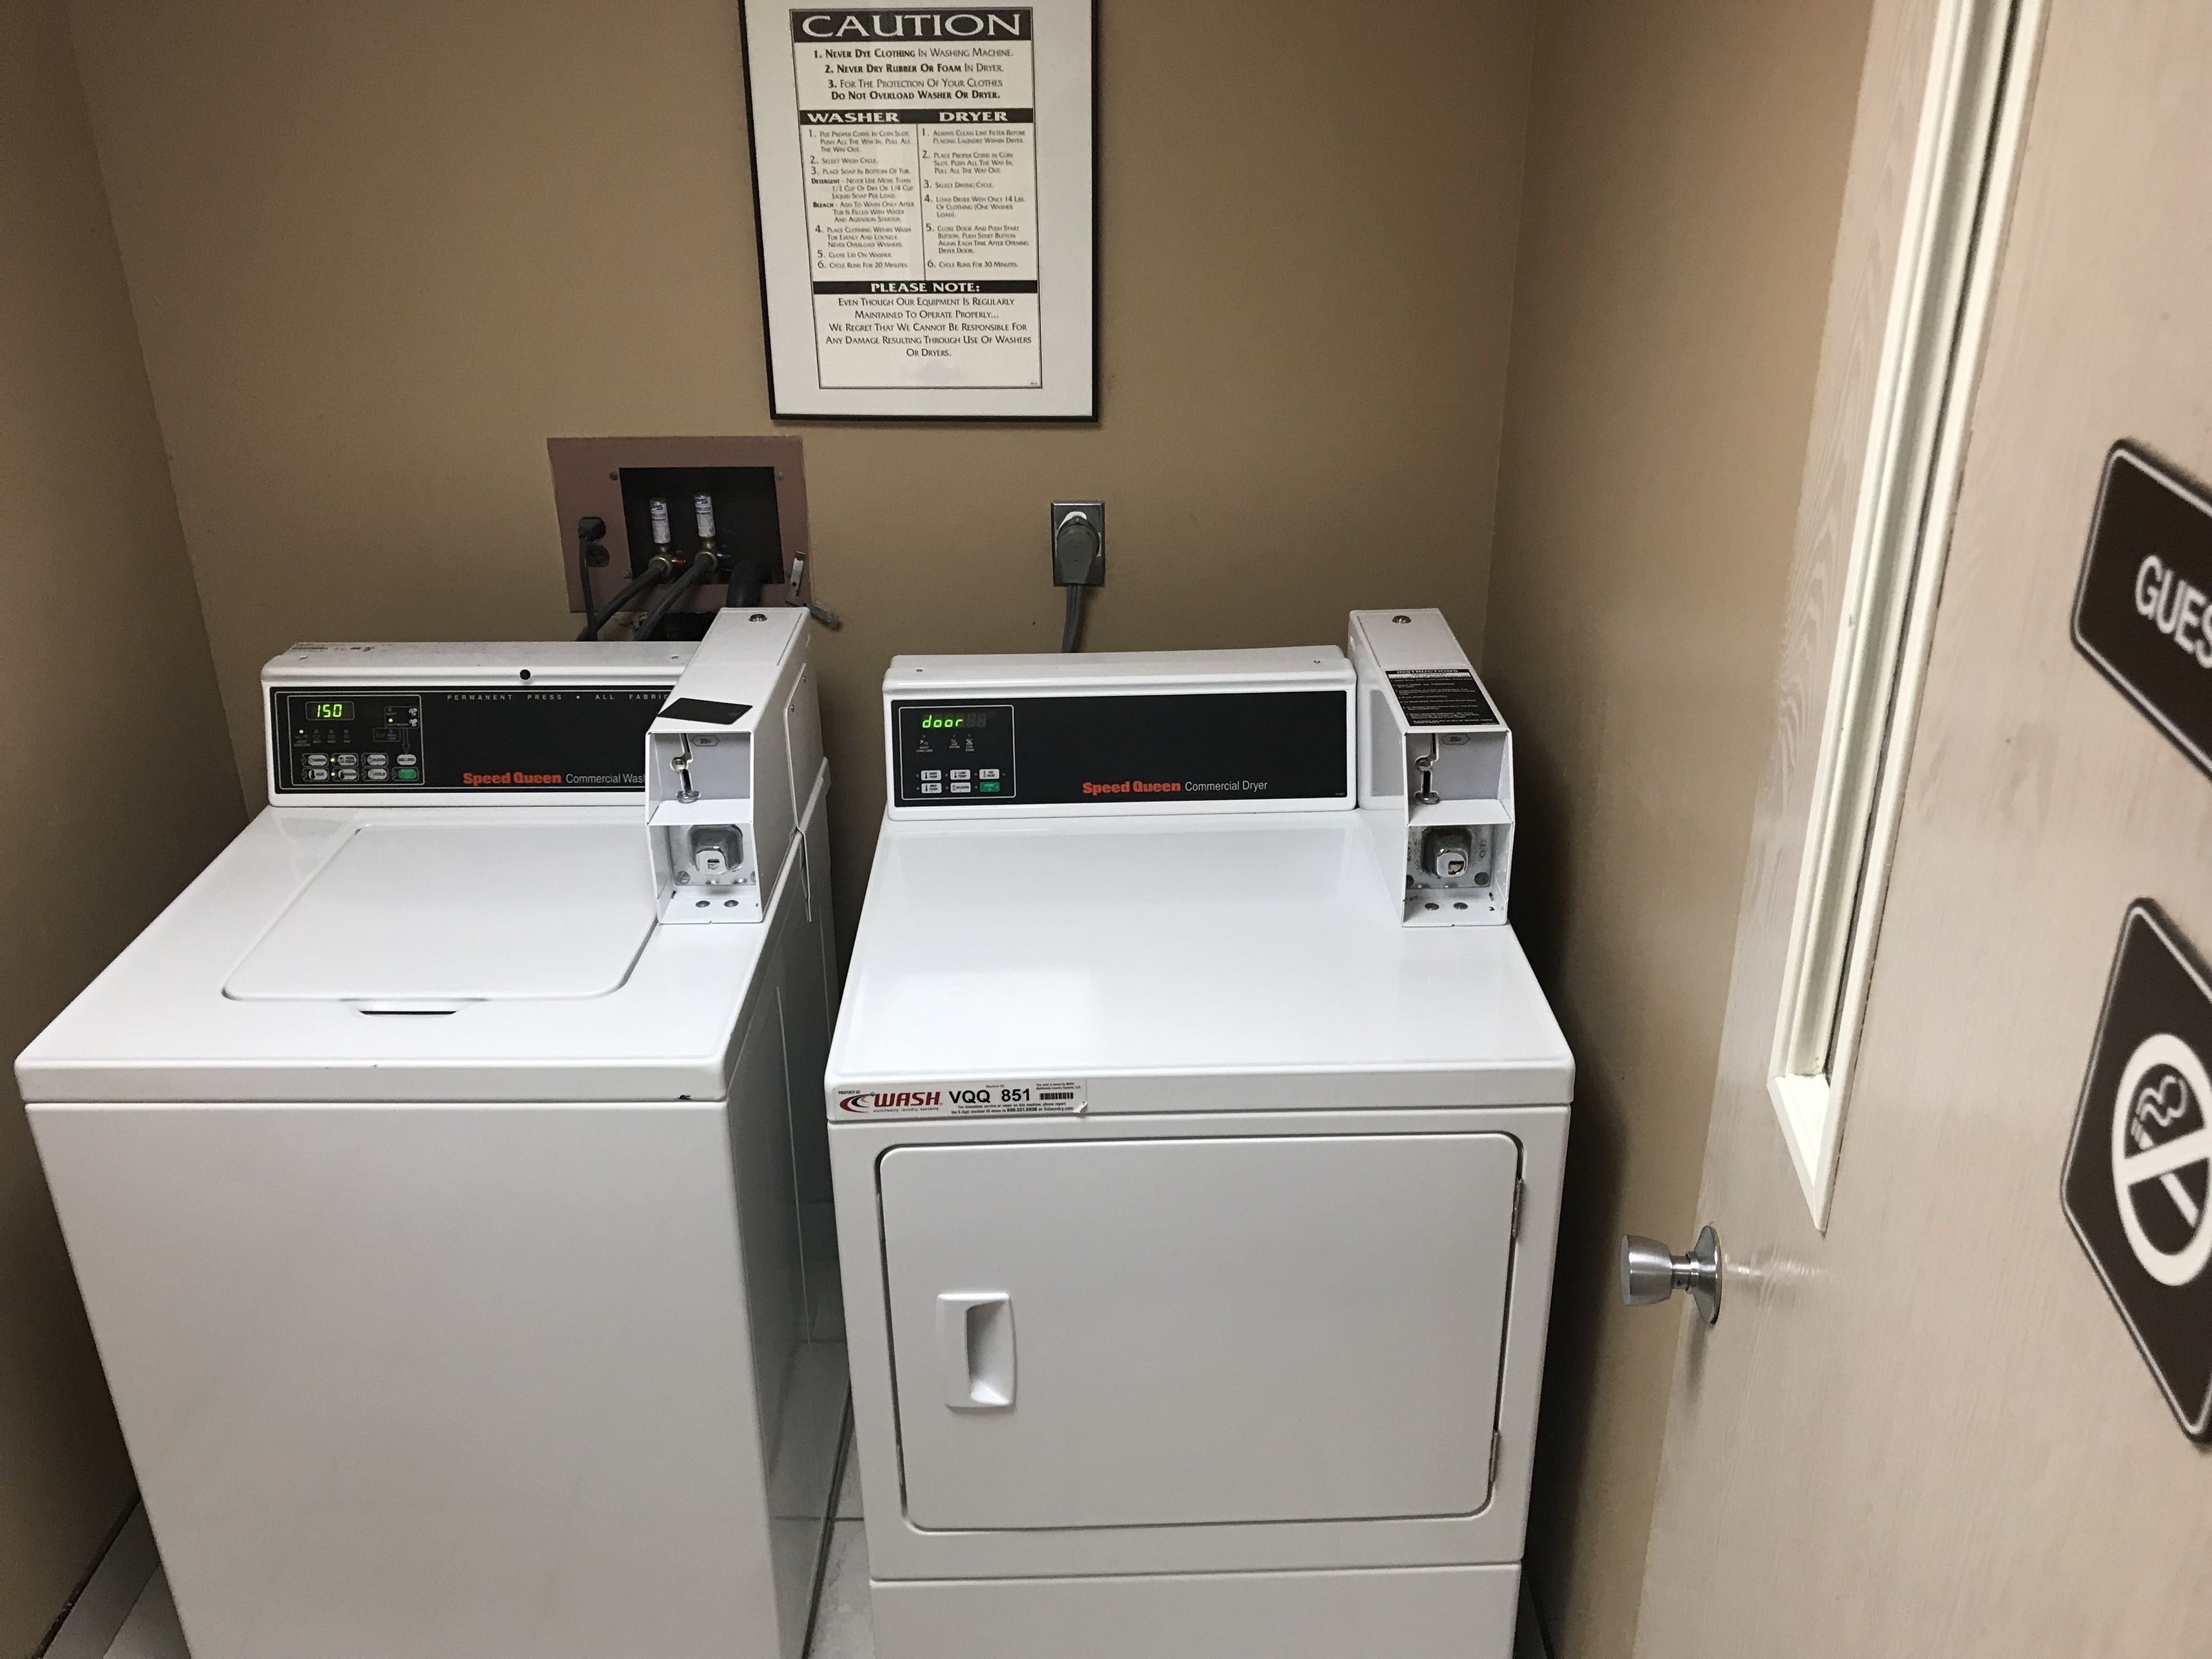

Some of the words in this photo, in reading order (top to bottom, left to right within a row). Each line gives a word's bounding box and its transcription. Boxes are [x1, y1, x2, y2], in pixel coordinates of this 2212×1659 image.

[802, 14, 1020, 37] CAUTION
[807, 112, 900, 122] WASHER
[940, 112, 1008, 122] DRYER
[871, 283, 927, 292] PLEASE
[933, 283, 980, 292] NOTE:
[838, 298, 858, 306] EVEN
[861, 298, 893, 306] THOUGH
[896, 297, 915, 305] OUR
[917, 297, 960, 306] EQUIPMENT
[963, 297, 969, 305] IS
[973, 297, 1014, 305] REGULARLY
[855, 310, 903, 319] MAINTAINED
[905, 310, 916, 319] TO
[919, 310, 952, 319] OPERATE
[846, 323, 872, 331] REGRET
[874, 323, 894, 331] THAT
[897, 323, 910, 331] WE
[913, 323, 946, 331] CANNOT
[962, 323, 1009, 331] RESPONSIBLE
[1012, 323, 1027, 331] FOR
[846, 336, 880, 344] DAMAGE
[882, 336, 921, 344] RESULTING
[995, 335, 1032, 343] WASHERS
[317, 704, 342, 718] 150
[922, 715, 963, 728] door
[463, 772, 511, 786] Speed
[513, 772, 562, 785] Queen
[566, 774, 620, 783] Commercial
[1082, 781, 1130, 796] Speed
[1132, 781, 1181, 793] Queen
[1185, 781, 1240, 791] Commercial
[1243, 781, 1268, 793] Dryer
[874, 1092, 940, 1107] WASH
[949, 1090, 990, 1104] VQQ
[1001, 1089, 1029, 1102] 851
